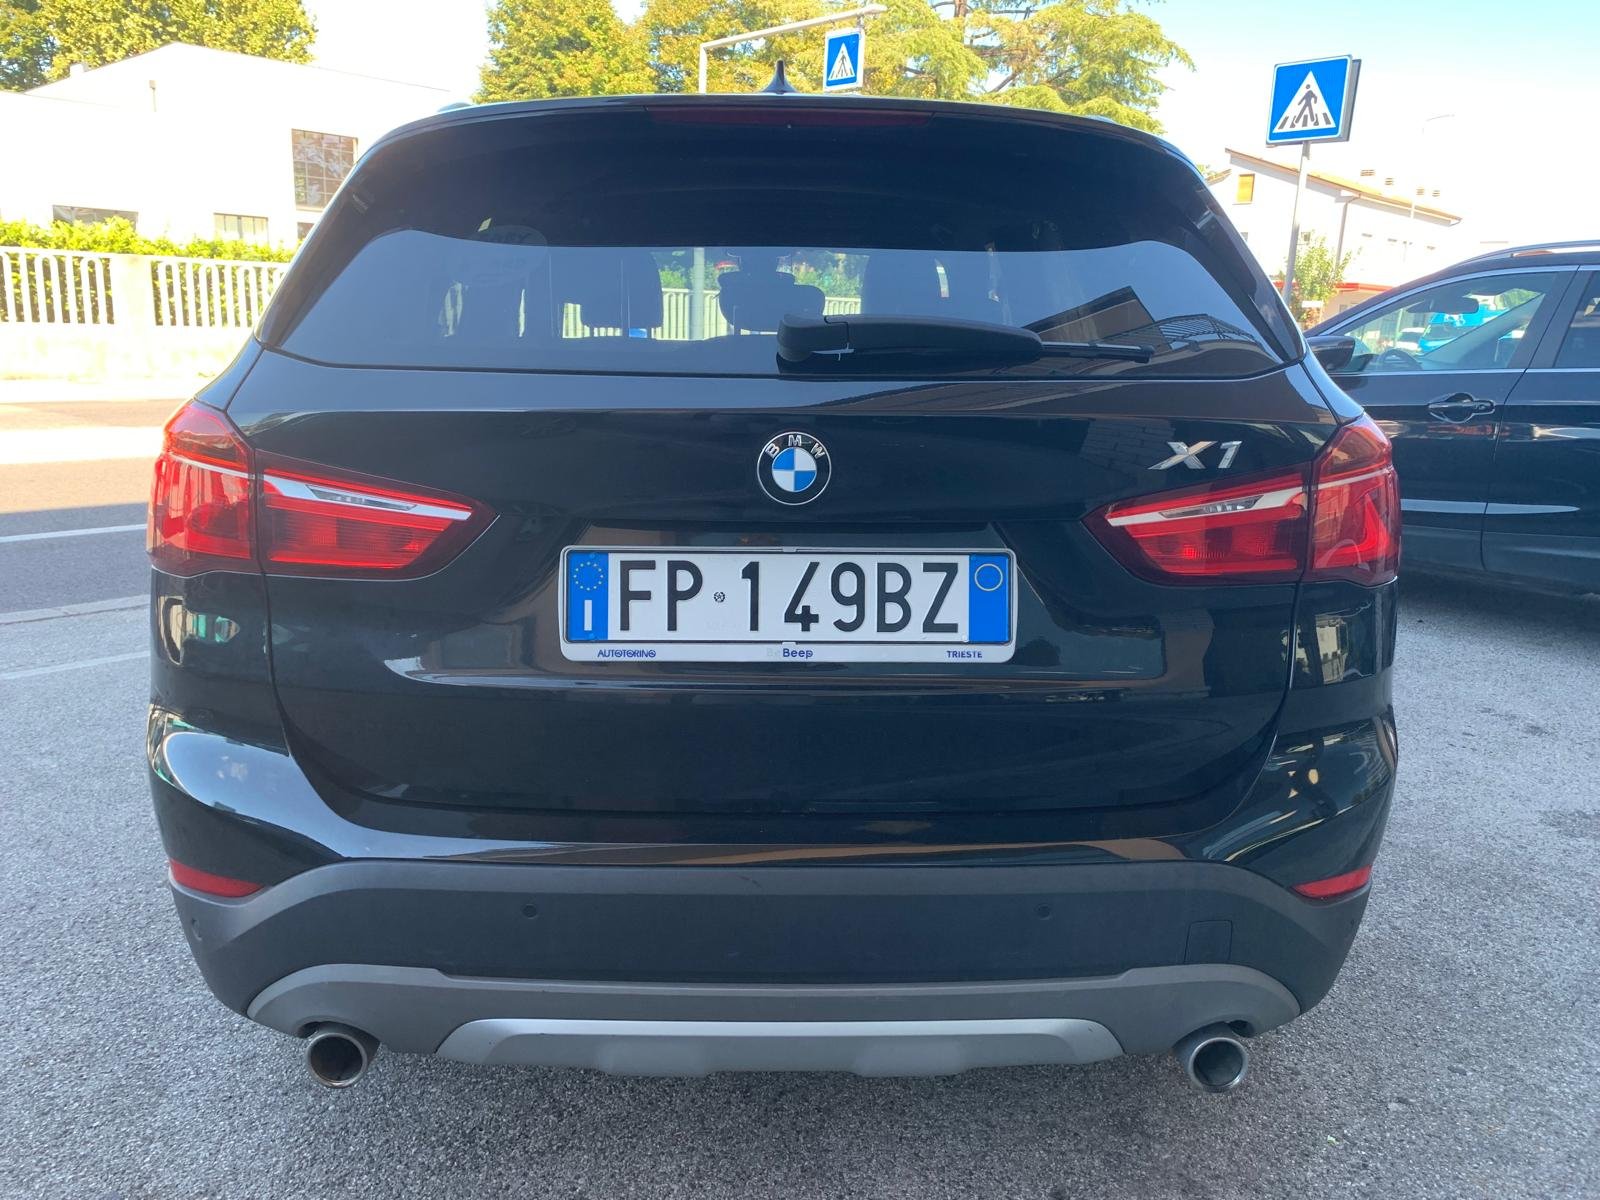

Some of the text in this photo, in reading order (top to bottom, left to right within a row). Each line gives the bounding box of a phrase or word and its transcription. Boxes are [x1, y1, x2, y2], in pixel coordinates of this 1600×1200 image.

[765, 434, 826, 459] BMW
[1148, 440, 1243, 470] X1
[618, 559, 959, 634] FP 149BZ
[597, 648, 657, 659] AUTOTORINO
[782, 647, 814, 660] Beep
[946, 649, 984, 659] TRIESTE
